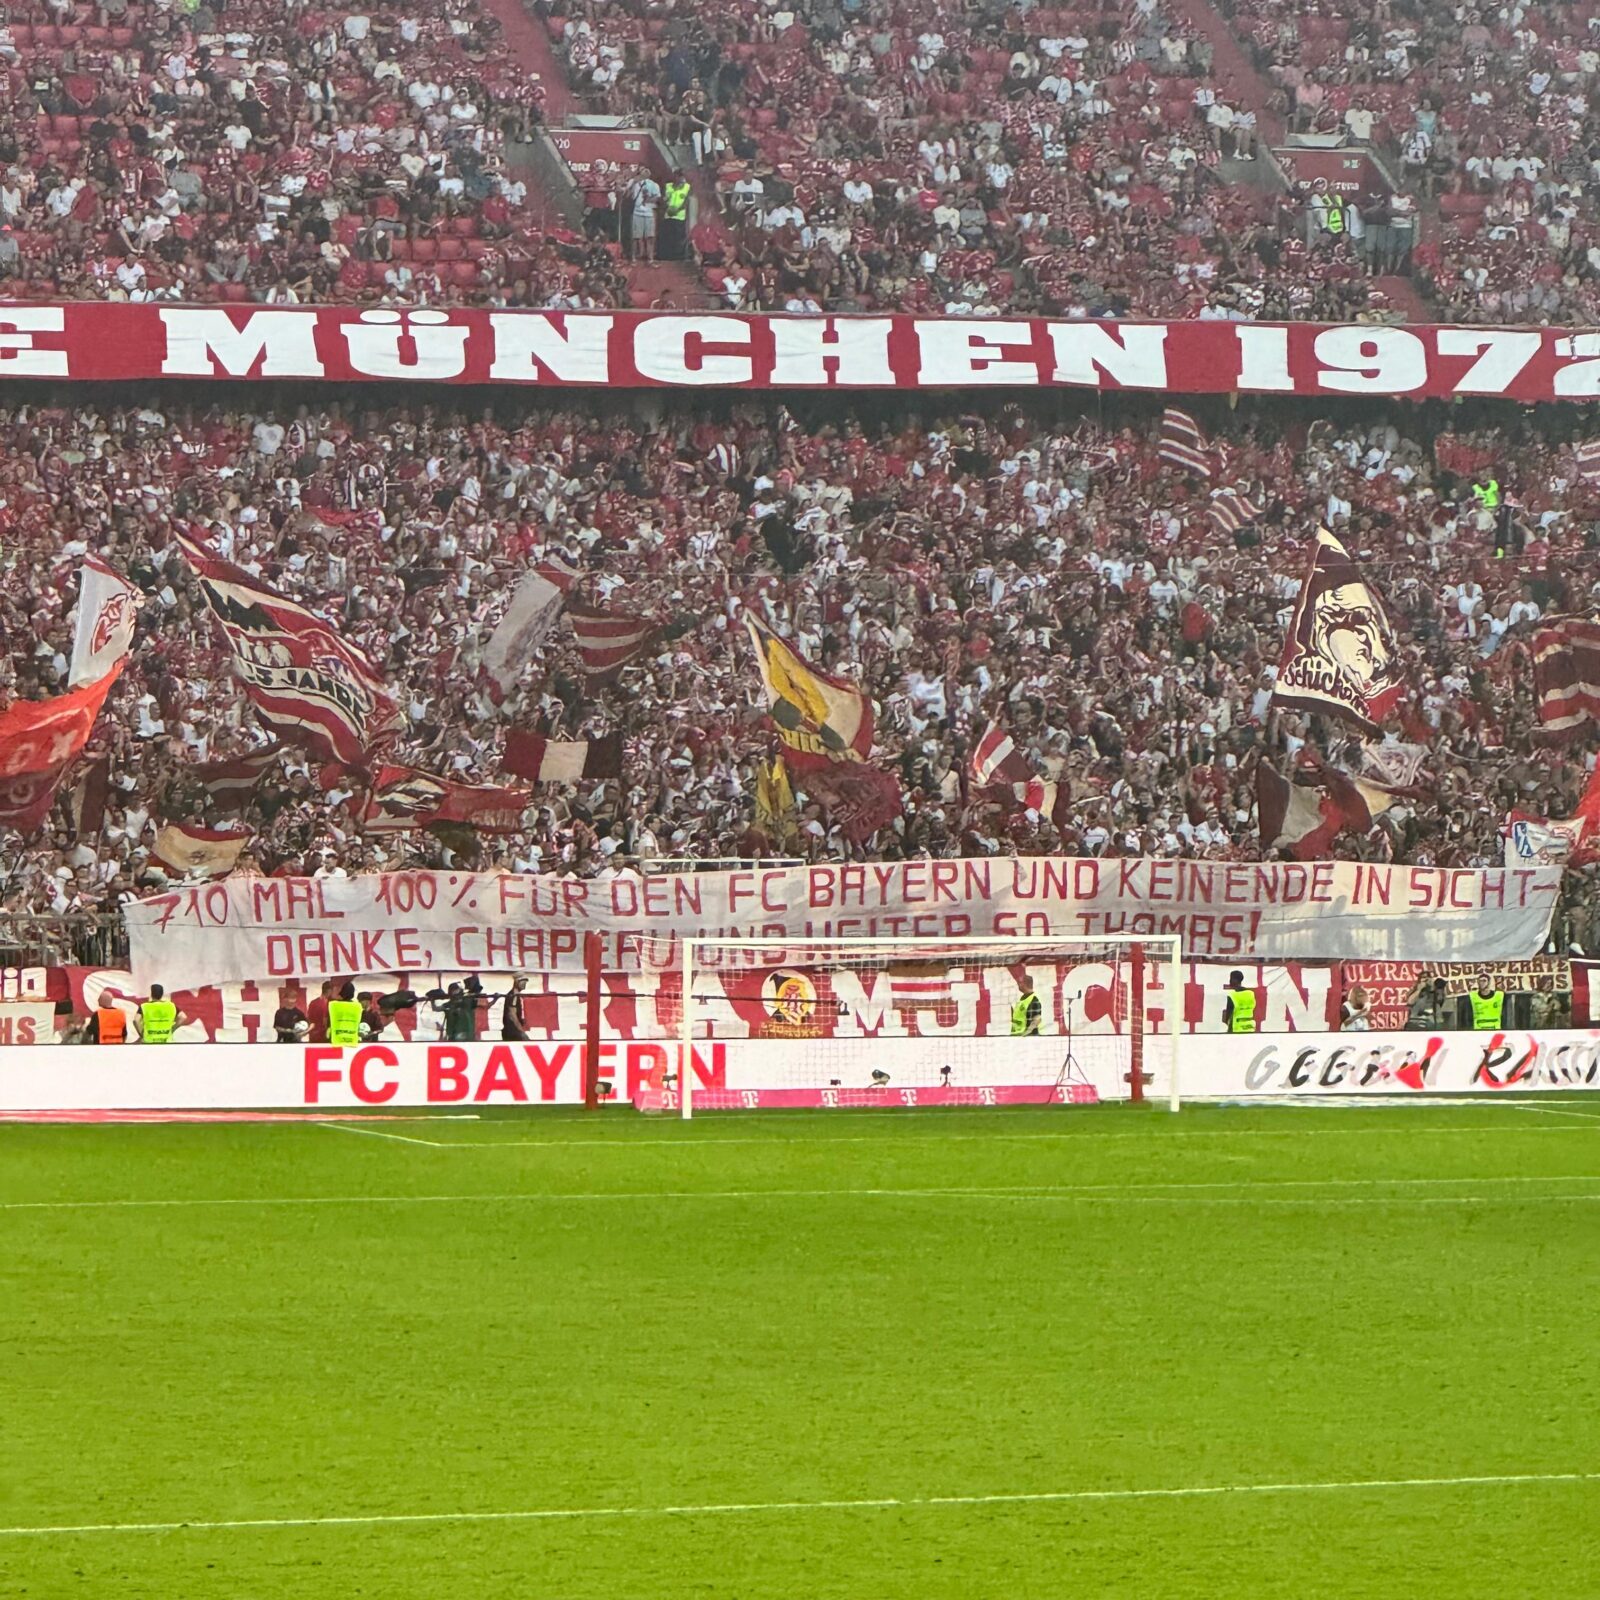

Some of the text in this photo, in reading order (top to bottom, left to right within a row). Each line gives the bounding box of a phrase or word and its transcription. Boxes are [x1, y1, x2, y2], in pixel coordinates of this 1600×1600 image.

[159, 310, 1167, 390] MÜNCHEN
[145, 885, 230, 934] 710
[254, 877, 345, 923] MAL
[500, 873, 589, 918] FÜR
[611, 876, 702, 917] DEN
[729, 871, 788, 913] FC
[809, 860, 991, 908] BAYERN
[1012, 859, 1099, 900] UND
[1119, 859, 1213, 904] KEIN
[1225, 862, 1334, 904] ENDE
[1351, 865, 1392, 905] IN
[266, 927, 433, 977] DANKE,
[1075, 910, 1263, 955] THOMAS!
[303, 1043, 727, 1104] FC BAYERN
